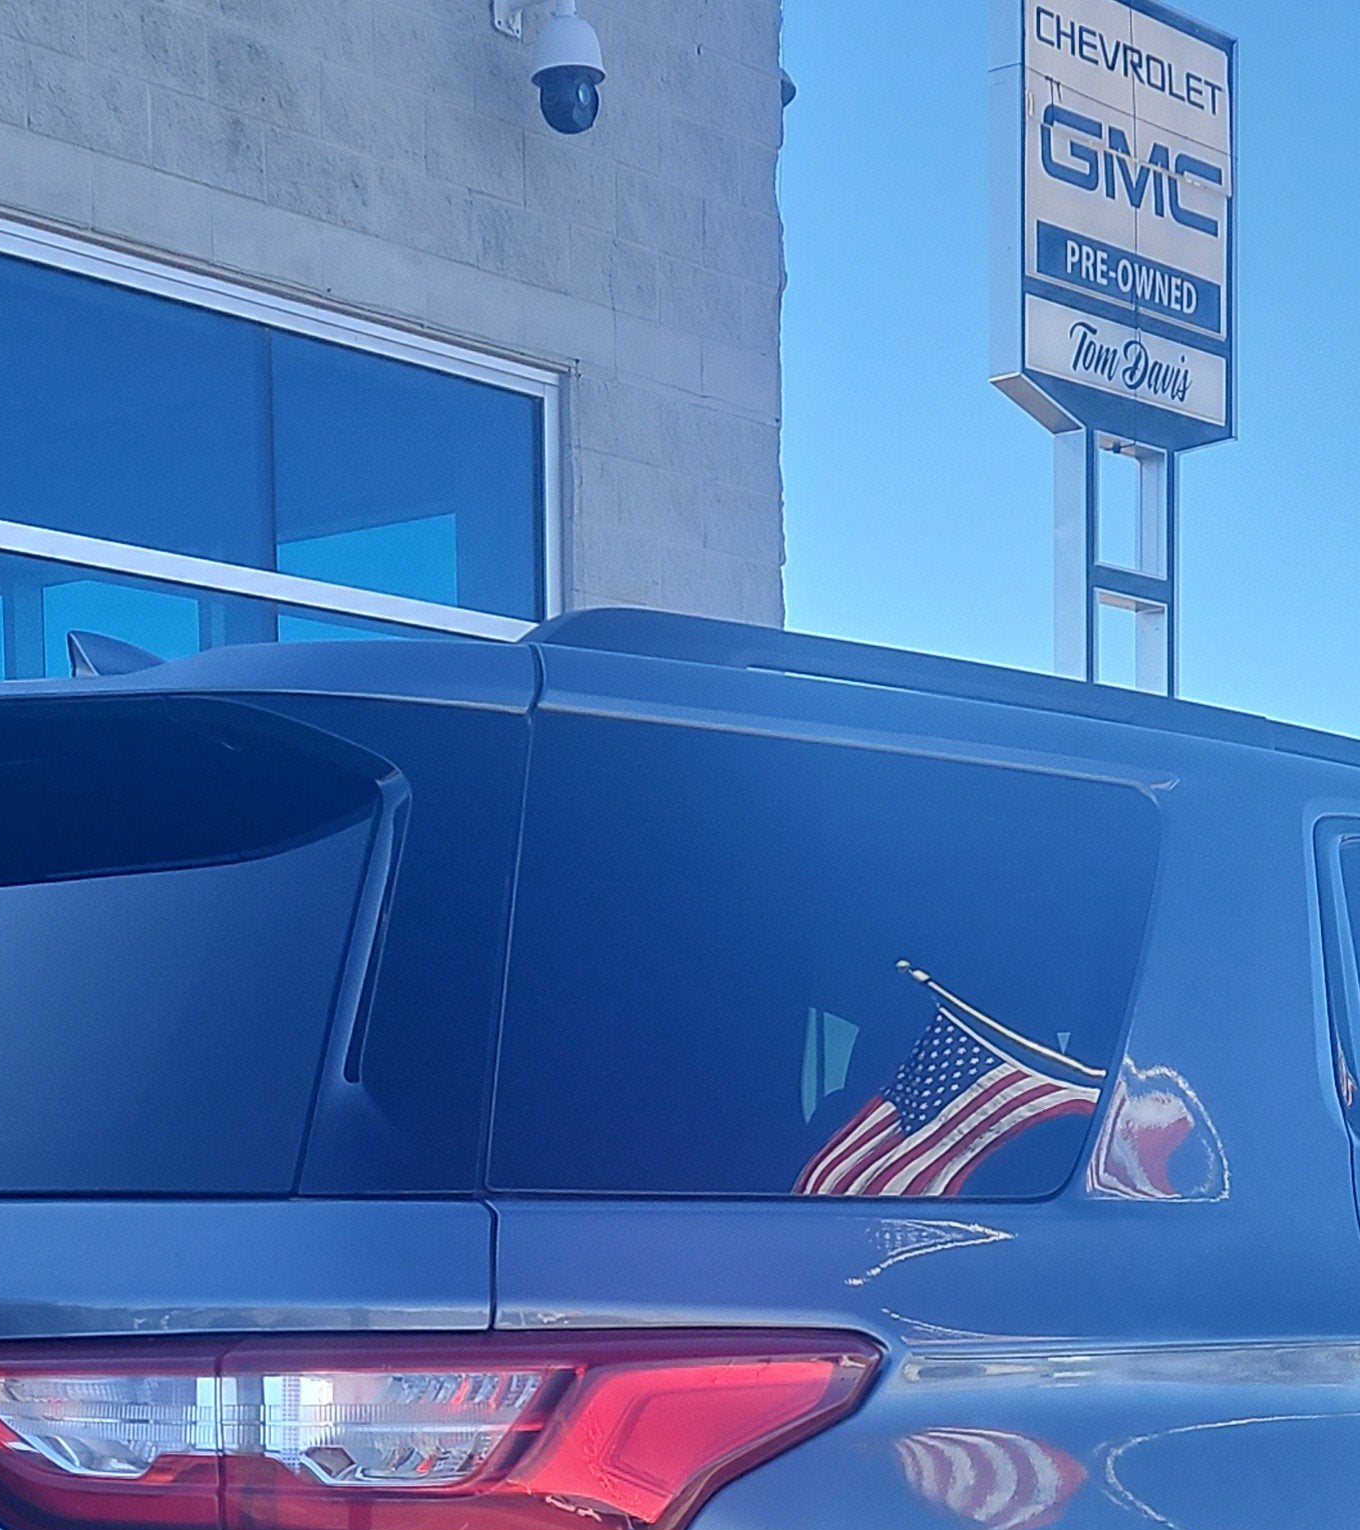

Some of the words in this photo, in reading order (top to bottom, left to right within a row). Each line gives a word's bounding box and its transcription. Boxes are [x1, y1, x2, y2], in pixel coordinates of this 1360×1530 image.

[1035, 5, 1223, 116] CHEVROLET
[1040, 102, 1223, 239] GMC
[1066, 240, 1197, 315] PRE-OWNED
[1069, 321, 1120, 382] Tom
[1122, 339, 1193, 403] Davis
